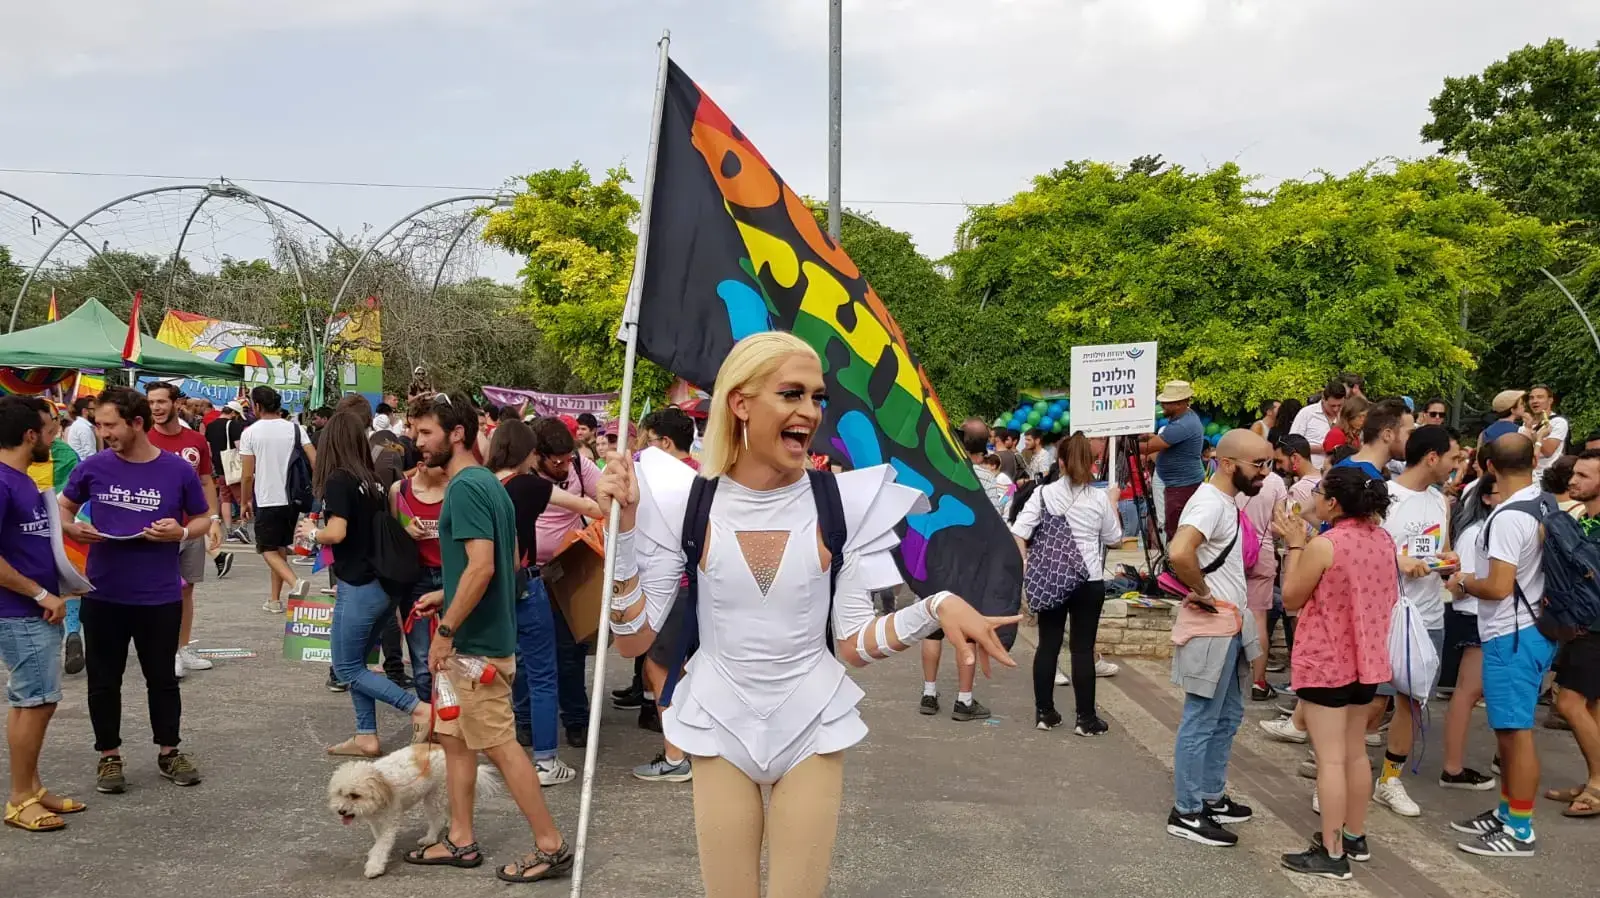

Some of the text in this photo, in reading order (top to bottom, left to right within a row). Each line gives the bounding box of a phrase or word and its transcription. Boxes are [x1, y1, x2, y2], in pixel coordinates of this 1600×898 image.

[1092, 367, 1136, 382] חילונים
[1093, 383, 1134, 397] צועדים
[559, 398, 585, 409] מלא
[1091, 397, 1136, 412] בגאווה!
[96, 493, 161, 506] עומדים ביחד
[1416, 545, 1430, 553] גאה
